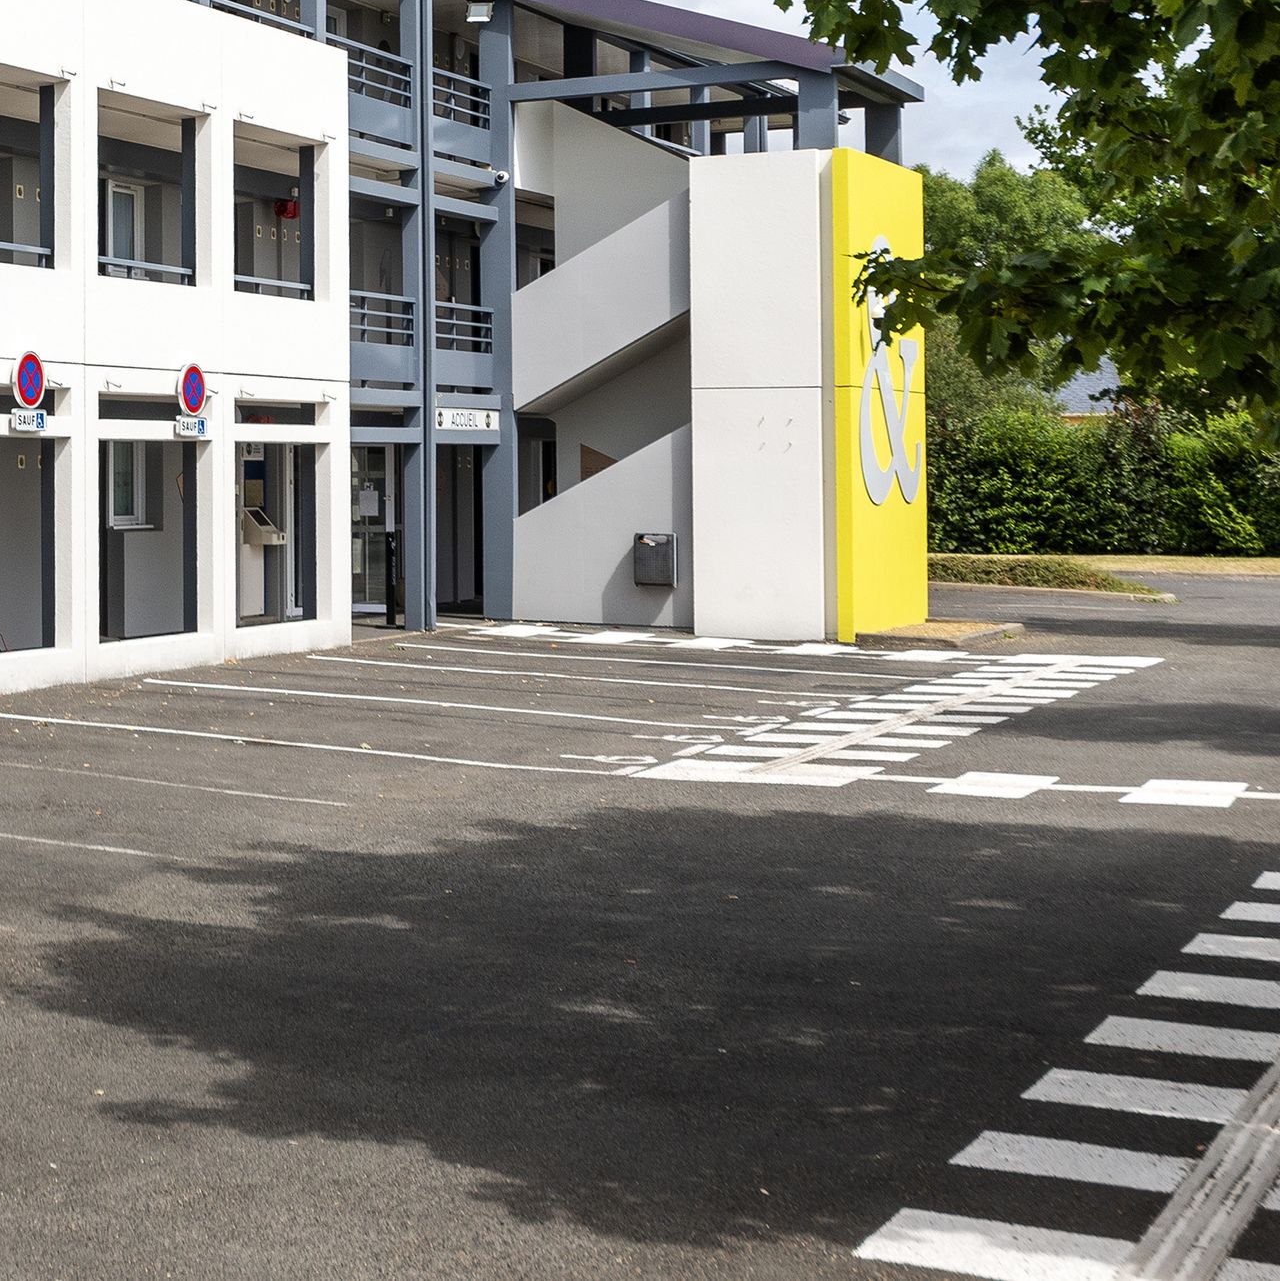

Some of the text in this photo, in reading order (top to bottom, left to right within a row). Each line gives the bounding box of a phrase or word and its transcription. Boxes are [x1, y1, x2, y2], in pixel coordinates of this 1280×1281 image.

[17, 414, 35, 426] SAUF
[181, 420, 197, 432] SAUF
[451, 412, 478, 428] ACCUEIL
